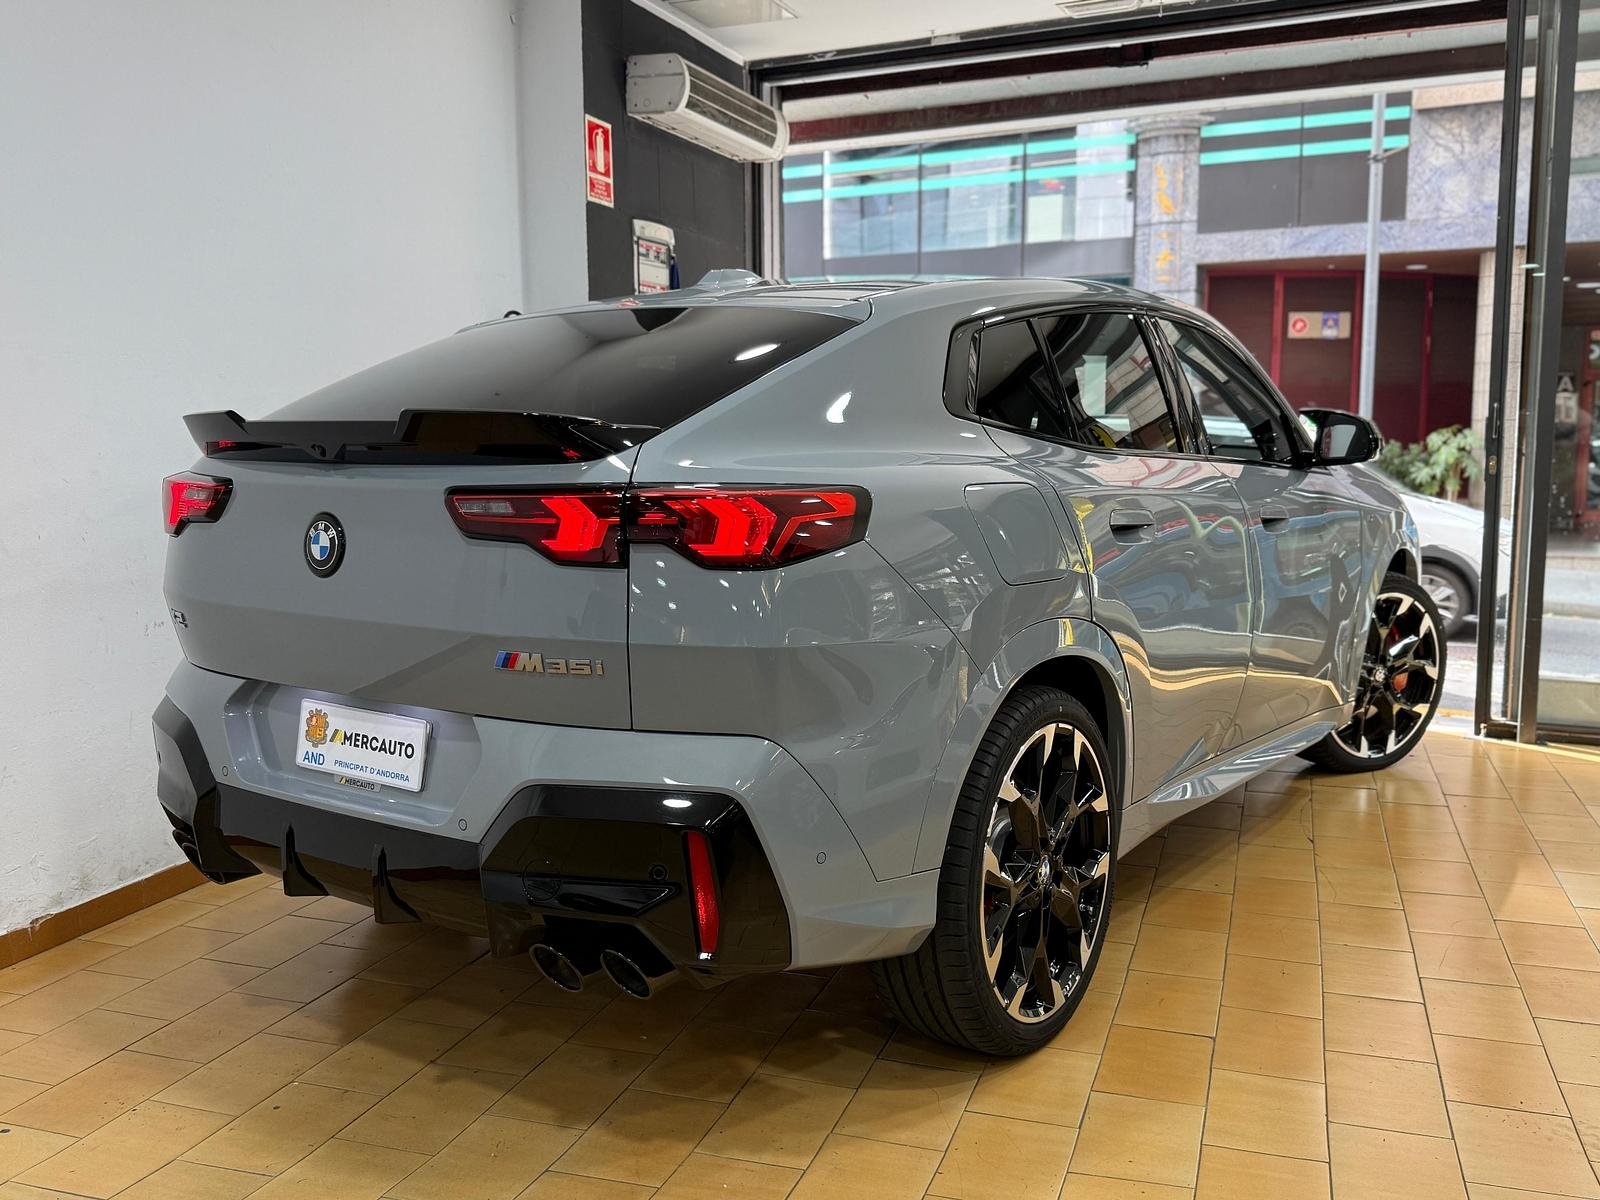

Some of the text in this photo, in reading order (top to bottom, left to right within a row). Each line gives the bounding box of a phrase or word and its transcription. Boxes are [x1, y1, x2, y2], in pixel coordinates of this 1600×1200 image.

[514, 650, 604, 675] M35i
[303, 750, 325, 766] AND
[334, 759, 410, 783] PRINCIPAT D'ANDORRA
